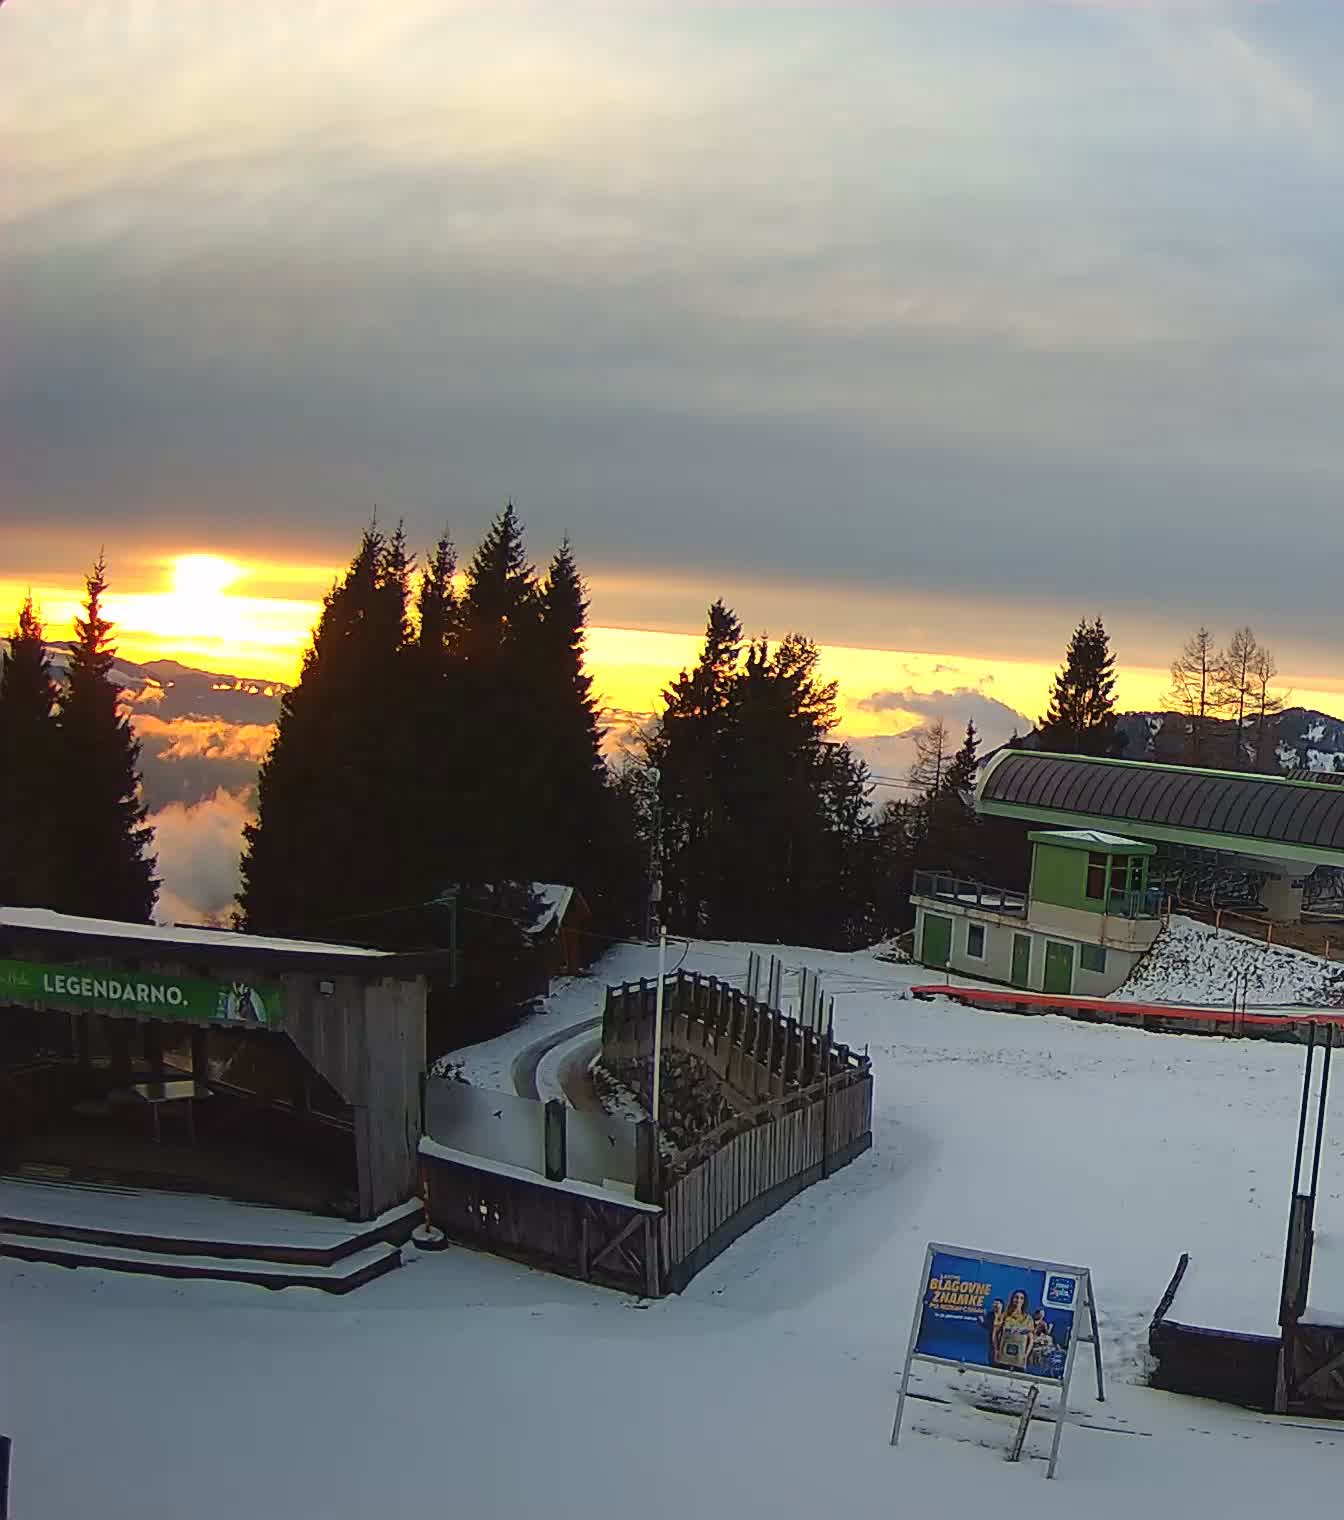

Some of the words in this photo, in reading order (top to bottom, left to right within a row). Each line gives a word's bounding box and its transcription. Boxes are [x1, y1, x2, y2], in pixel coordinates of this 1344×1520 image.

[43, 973, 189, 1006] LEGENDARNO.
[929, 1278, 992, 1296] BLAGOVNE
[931, 1290, 985, 1307] ZNAMKE
